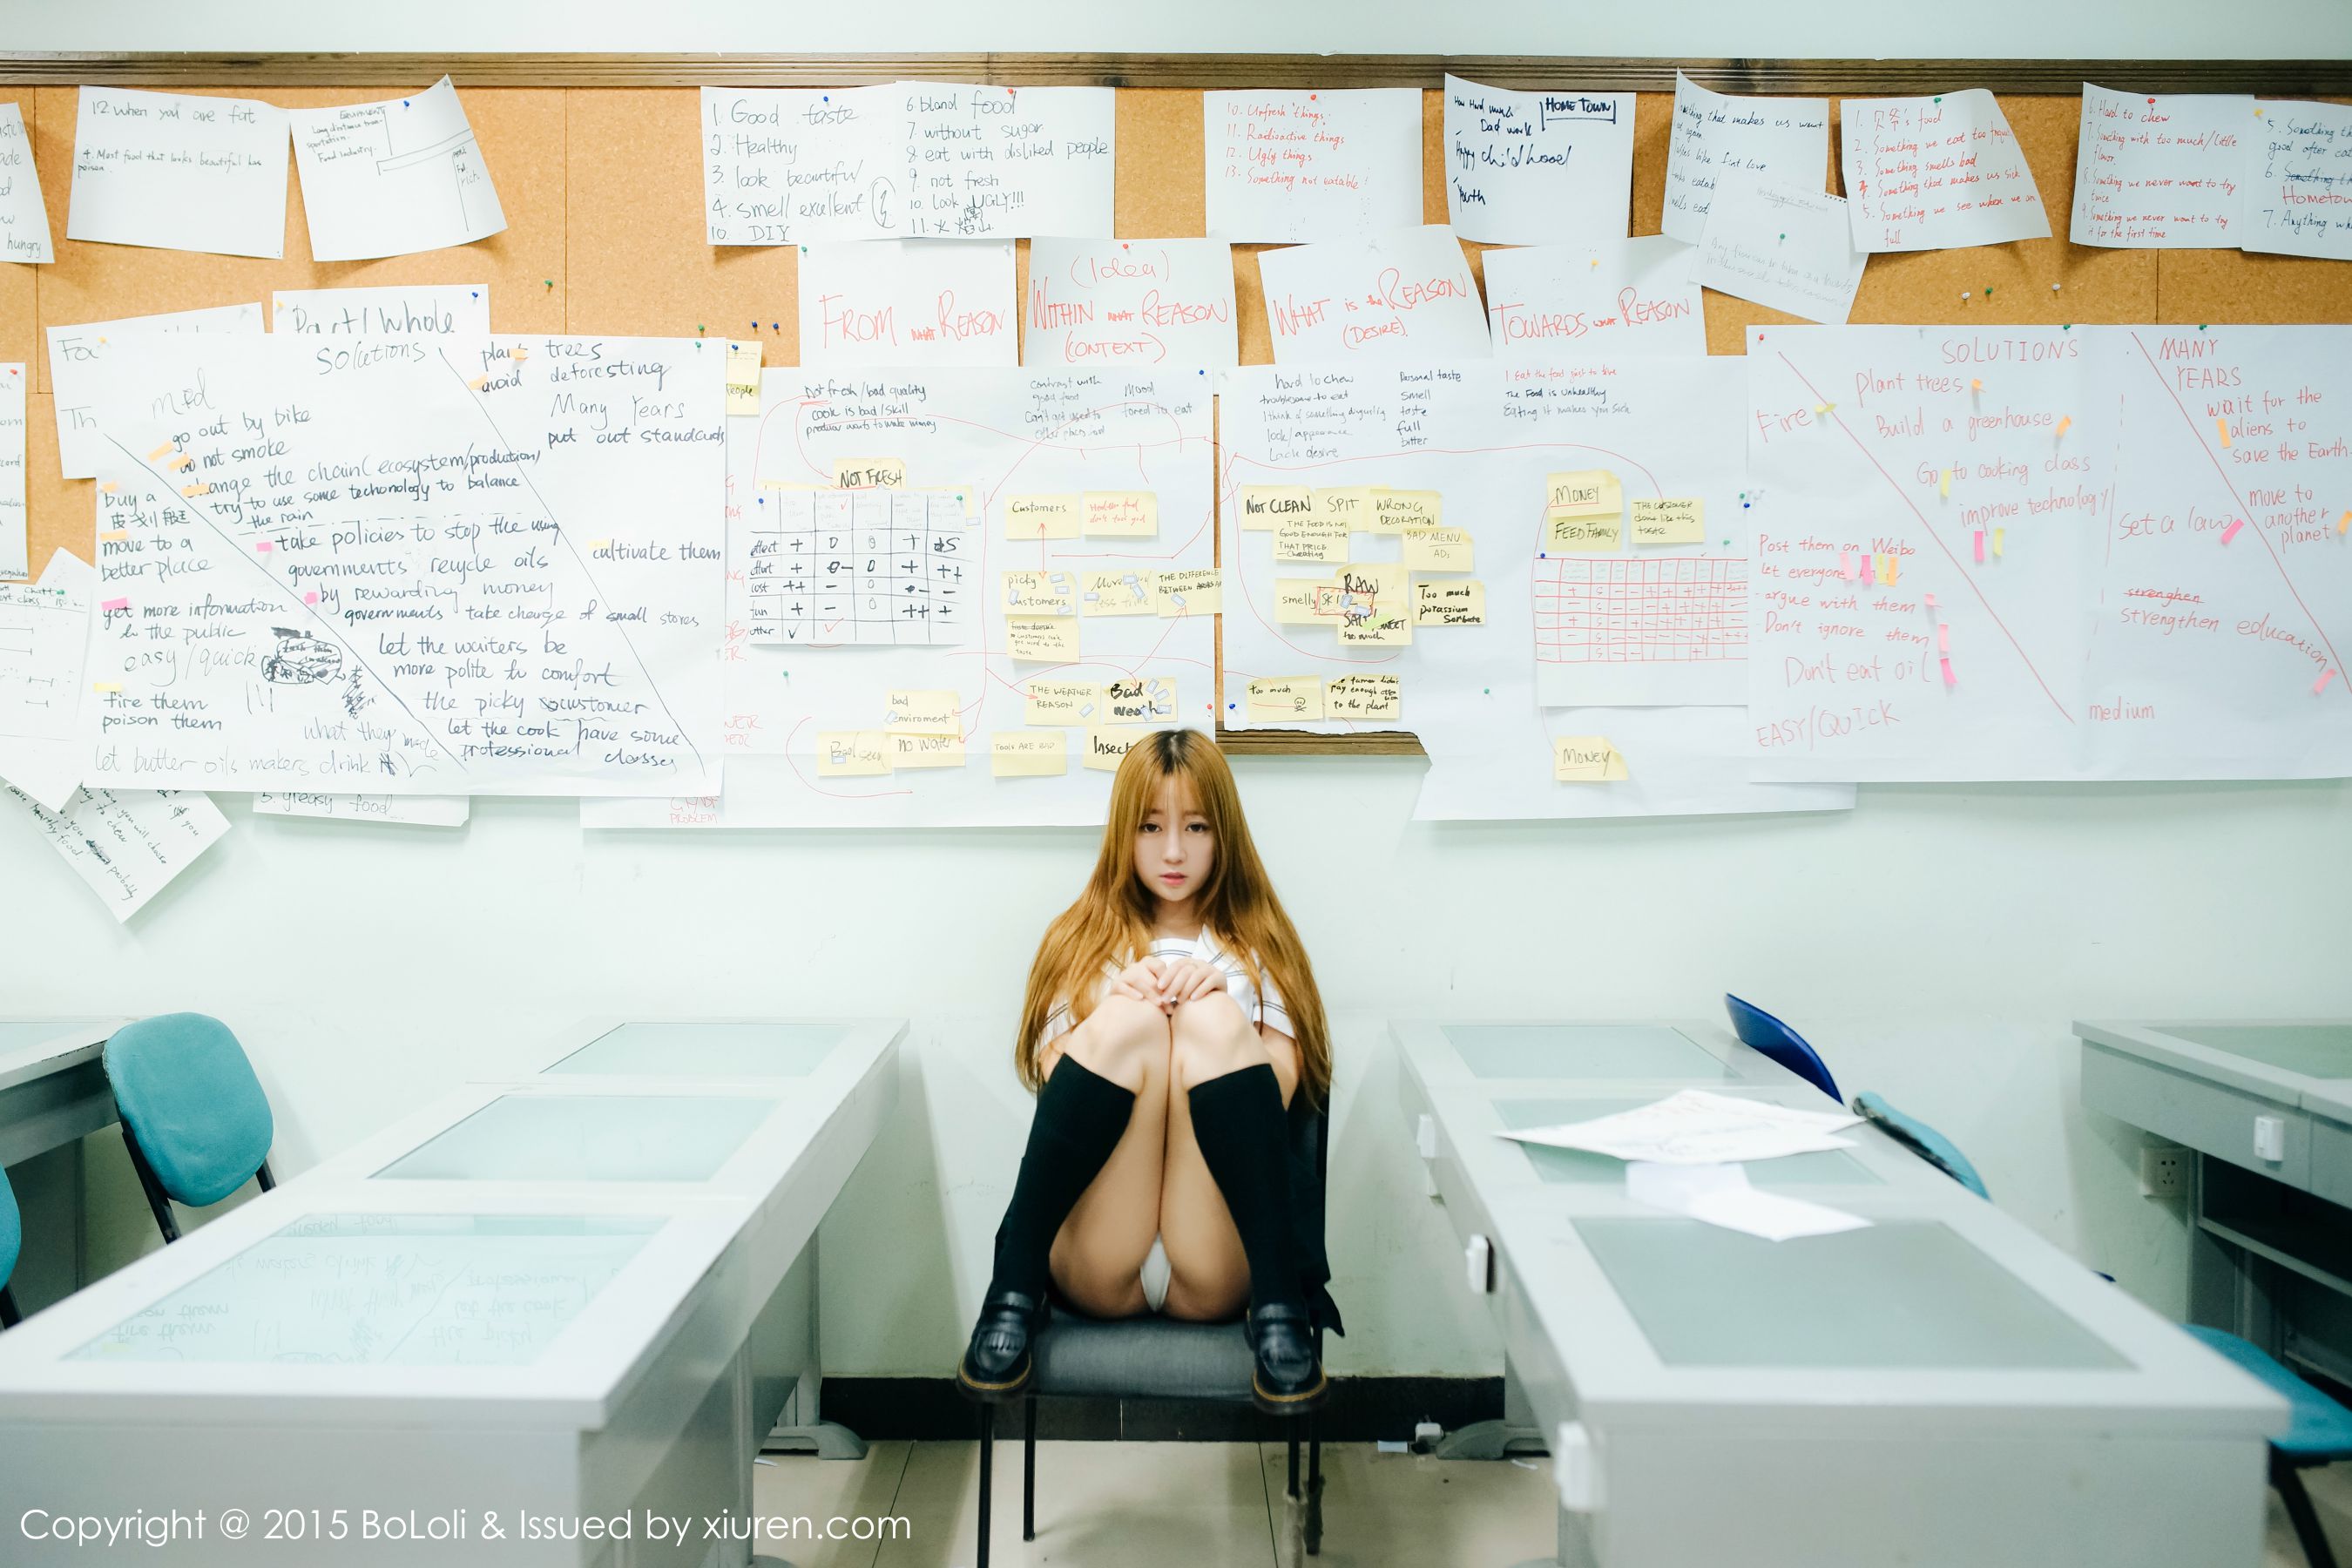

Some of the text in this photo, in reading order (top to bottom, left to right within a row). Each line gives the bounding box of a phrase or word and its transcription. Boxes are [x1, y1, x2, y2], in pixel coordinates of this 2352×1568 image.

[159, 109, 179, 121] you
[193, 110, 215, 123] are
[228, 105, 256, 125] fat
[731, 98, 858, 126] Good taste
[920, 90, 1017, 120] bland food
[1247, 103, 1287, 123] Unfresh
[1544, 96, 1615, 114] HOME TOWN
[2099, 101, 2171, 124] Hard to chew
[1480, 118, 1532, 137] Dad work
[1707, 109, 1791, 128] that makes us
[1917, 107, 1943, 132] food
[924, 123, 982, 141] without
[1247, 123, 1345, 151] Radioactive things
[96, 148, 262, 173] Most food that looks beautiful has
[735, 132, 798, 165] Healthy
[924, 139, 1054, 162] eat with disliked
[1247, 145, 1313, 168] Ugly things
[2268, 140, 2328, 161] good after
[736, 159, 863, 189] look beautiful
[1875, 151, 1978, 179] Something smells bad
[930, 170, 999, 191] not fresh
[1247, 167, 1359, 193] Something not eatable
[736, 193, 790, 220] smell
[932, 190, 1024, 213] look UGLY!!!
[7, 232, 43, 260] hungry
[747, 225, 791, 243] DIY
[1884, 227, 1901, 248] full
[1032, 274, 1094, 331] WITHIN
[1141, 288, 1228, 328] REASON
[1272, 267, 1468, 336] WHAT is the REASON
[818, 294, 897, 349] FROM
[937, 289, 1004, 341] REASON
[1489, 287, 1690, 347] TOWARDS REASON
[544, 339, 603, 362] trees
[1064, 330, 1166, 364] (CONTEXT)
[1942, 336, 2078, 364] SOLUTIONS
[2159, 337, 2219, 361] MANY
[2176, 365, 2241, 391] YEARS
[2207, 385, 2322, 419] wait for the
[171, 403, 312, 454] go out by bike
[1876, 406, 2052, 443] Build a greenhouse
[2231, 416, 2307, 438] aliens to
[547, 426, 632, 450] put out
[202, 437, 291, 470] not smoke
[2232, 441, 2299, 464] save the
[835, 468, 902, 490] NOT FRESH
[1916, 456, 2090, 484] Go to cooking class
[1268, 494, 1312, 514] CLEAN
[1327, 495, 1360, 513] SPIT
[1375, 497, 1423, 516] WRONG
[1555, 485, 1600, 506] MONEY
[2249, 483, 2313, 507] move to
[1379, 513, 1435, 527] DECORATION
[1961, 484, 2109, 537] improve technology
[2265, 507, 2329, 530] another
[1554, 521, 1619, 544] FEED FAMILY
[2281, 524, 2330, 554] planet
[102, 534, 194, 558] move to a
[1760, 533, 1916, 558] Post them on Weibo
[1342, 572, 1379, 595] RAW
[1417, 584, 1470, 600] Too much
[1281, 591, 1318, 611] smelly
[1765, 591, 1916, 612] argue with them
[1765, 611, 1929, 645] Don't ignore them
[2120, 607, 2329, 671] strengthen education
[378, 629, 568, 657] let the waiters be
[1785, 656, 1931, 683] Don't eat oil
[891, 693, 909, 707] bad
[1036, 700, 1073, 709] REASON
[1333, 698, 1389, 715] to the plant
[2090, 696, 2150, 720] medium
[101, 712, 222, 734] poison them
[1560, 747, 1612, 776] MONEY
